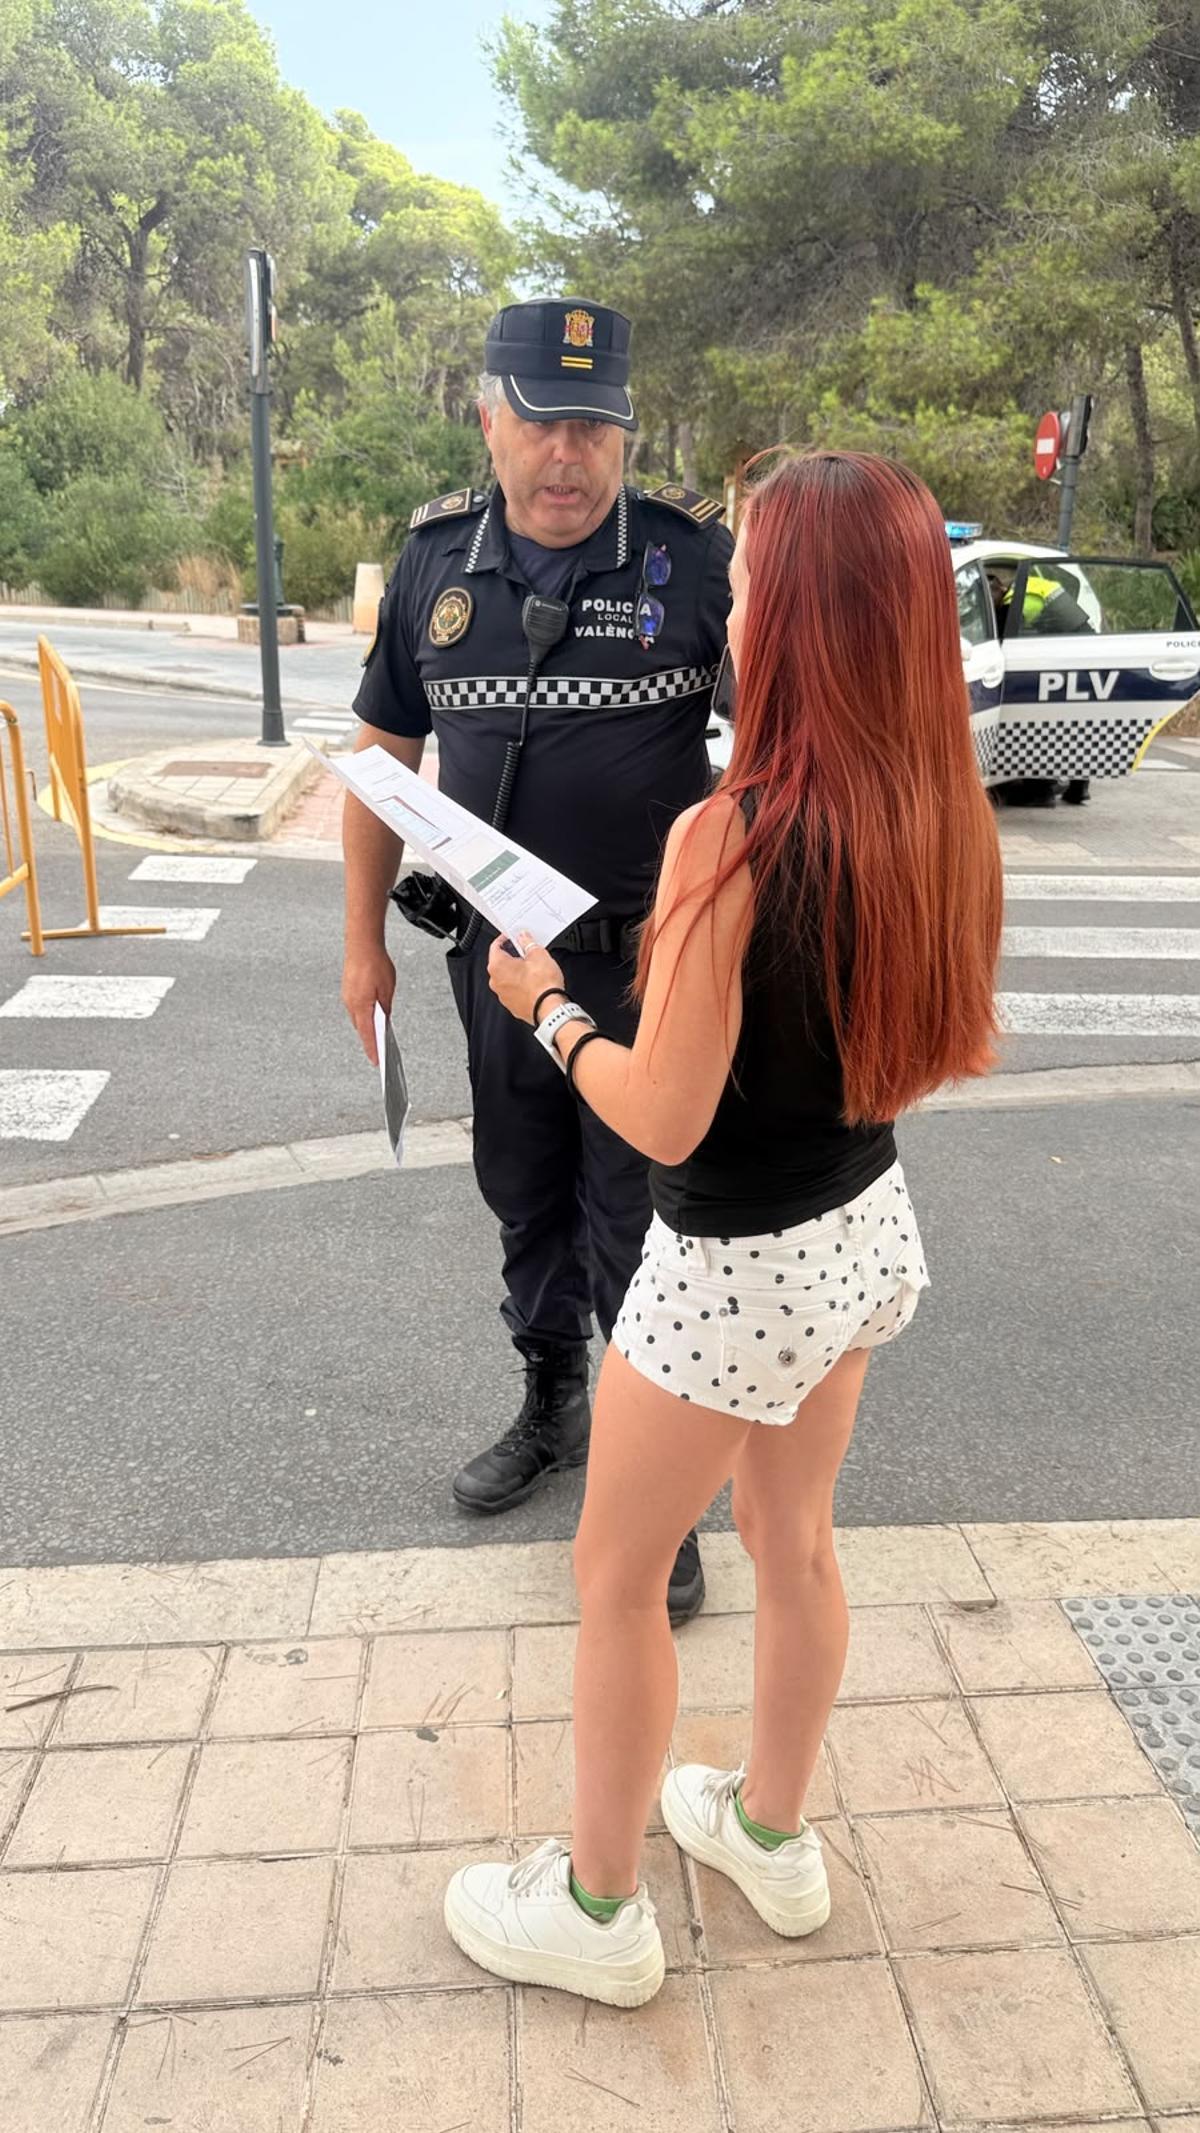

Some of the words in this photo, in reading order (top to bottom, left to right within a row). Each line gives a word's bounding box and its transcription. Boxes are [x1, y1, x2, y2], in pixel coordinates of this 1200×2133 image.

[582, 598, 652, 616] POLICA
[597, 612, 633, 624] LOCAL
[574, 623, 655, 644] VALÈNCA
[1038, 671, 1120, 701] PLV
